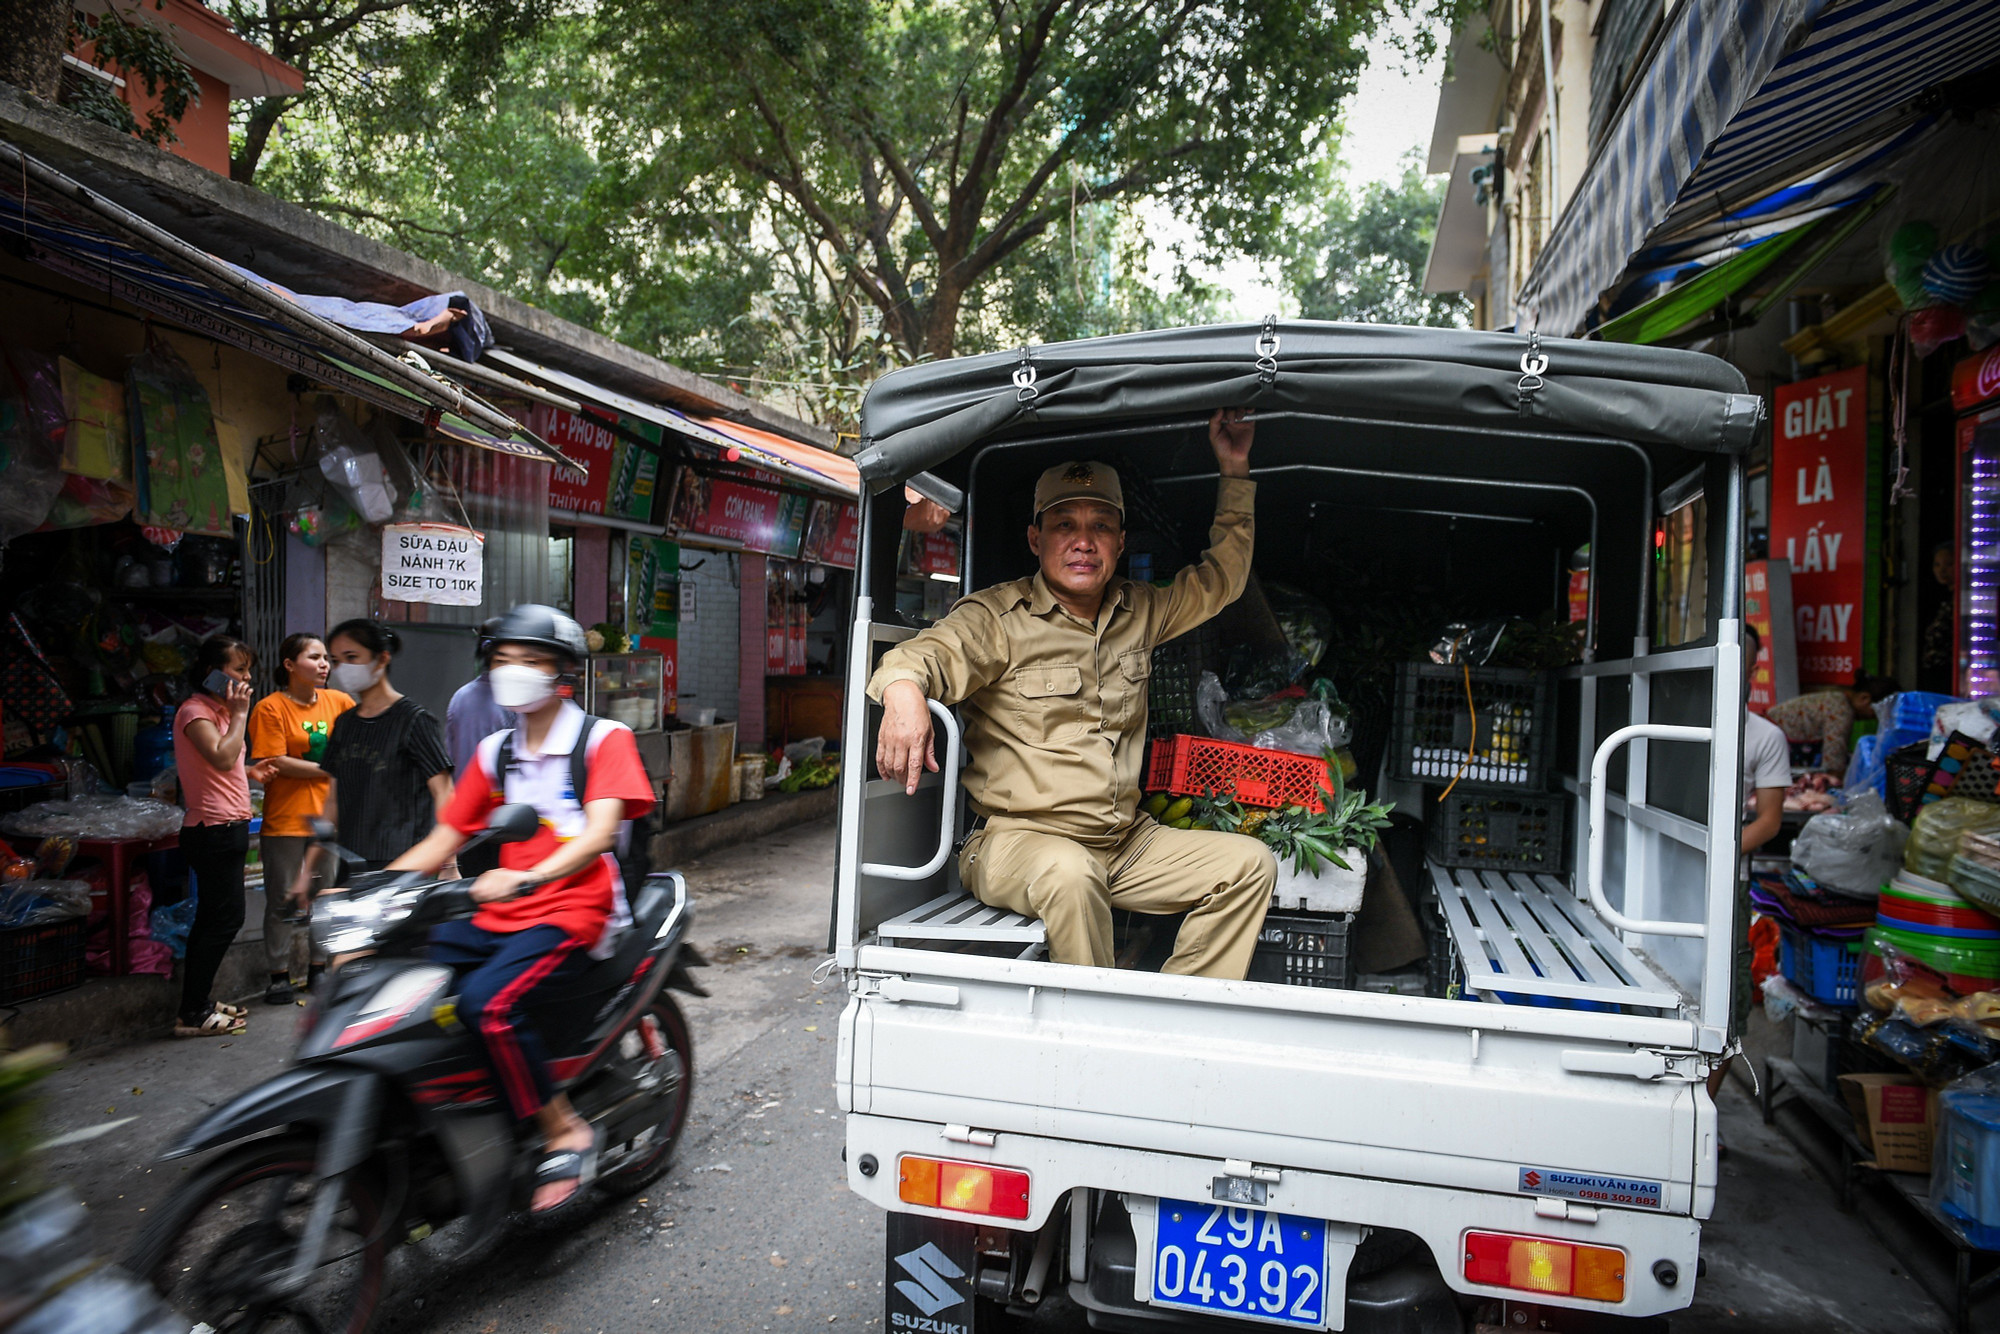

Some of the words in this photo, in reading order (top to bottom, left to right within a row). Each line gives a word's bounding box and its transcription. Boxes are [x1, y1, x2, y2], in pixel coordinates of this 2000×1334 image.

[1784, 385, 1853, 441] GIẶT
[1797, 456, 1834, 505] LÀ
[724, 494, 743, 521] CƠM
[743, 498, 766, 525] RANG
[1787, 521, 1843, 573] LẤY
[448, 559, 466, 571] 7K
[388, 575, 421, 588] SIZE
[426, 577, 446, 589] TO
[451, 579, 477, 592] 10K
[1797, 603, 1854, 643] GAY
[1550, 1173, 1596, 1187] SUZUKI
[1598, 1176, 1626, 1190] VÂN
[1629, 1182, 1658, 1195] ĐẠO
[1579, 1189, 1609, 1200] 0988
[1611, 1193, 1632, 1203] 302
[1635, 1196, 1657, 1206] 882
[1196, 1205, 1284, 1255] 29A
[1158, 1245, 1319, 1320] 043.92
[891, 1312, 968, 1334] SUZUKI
